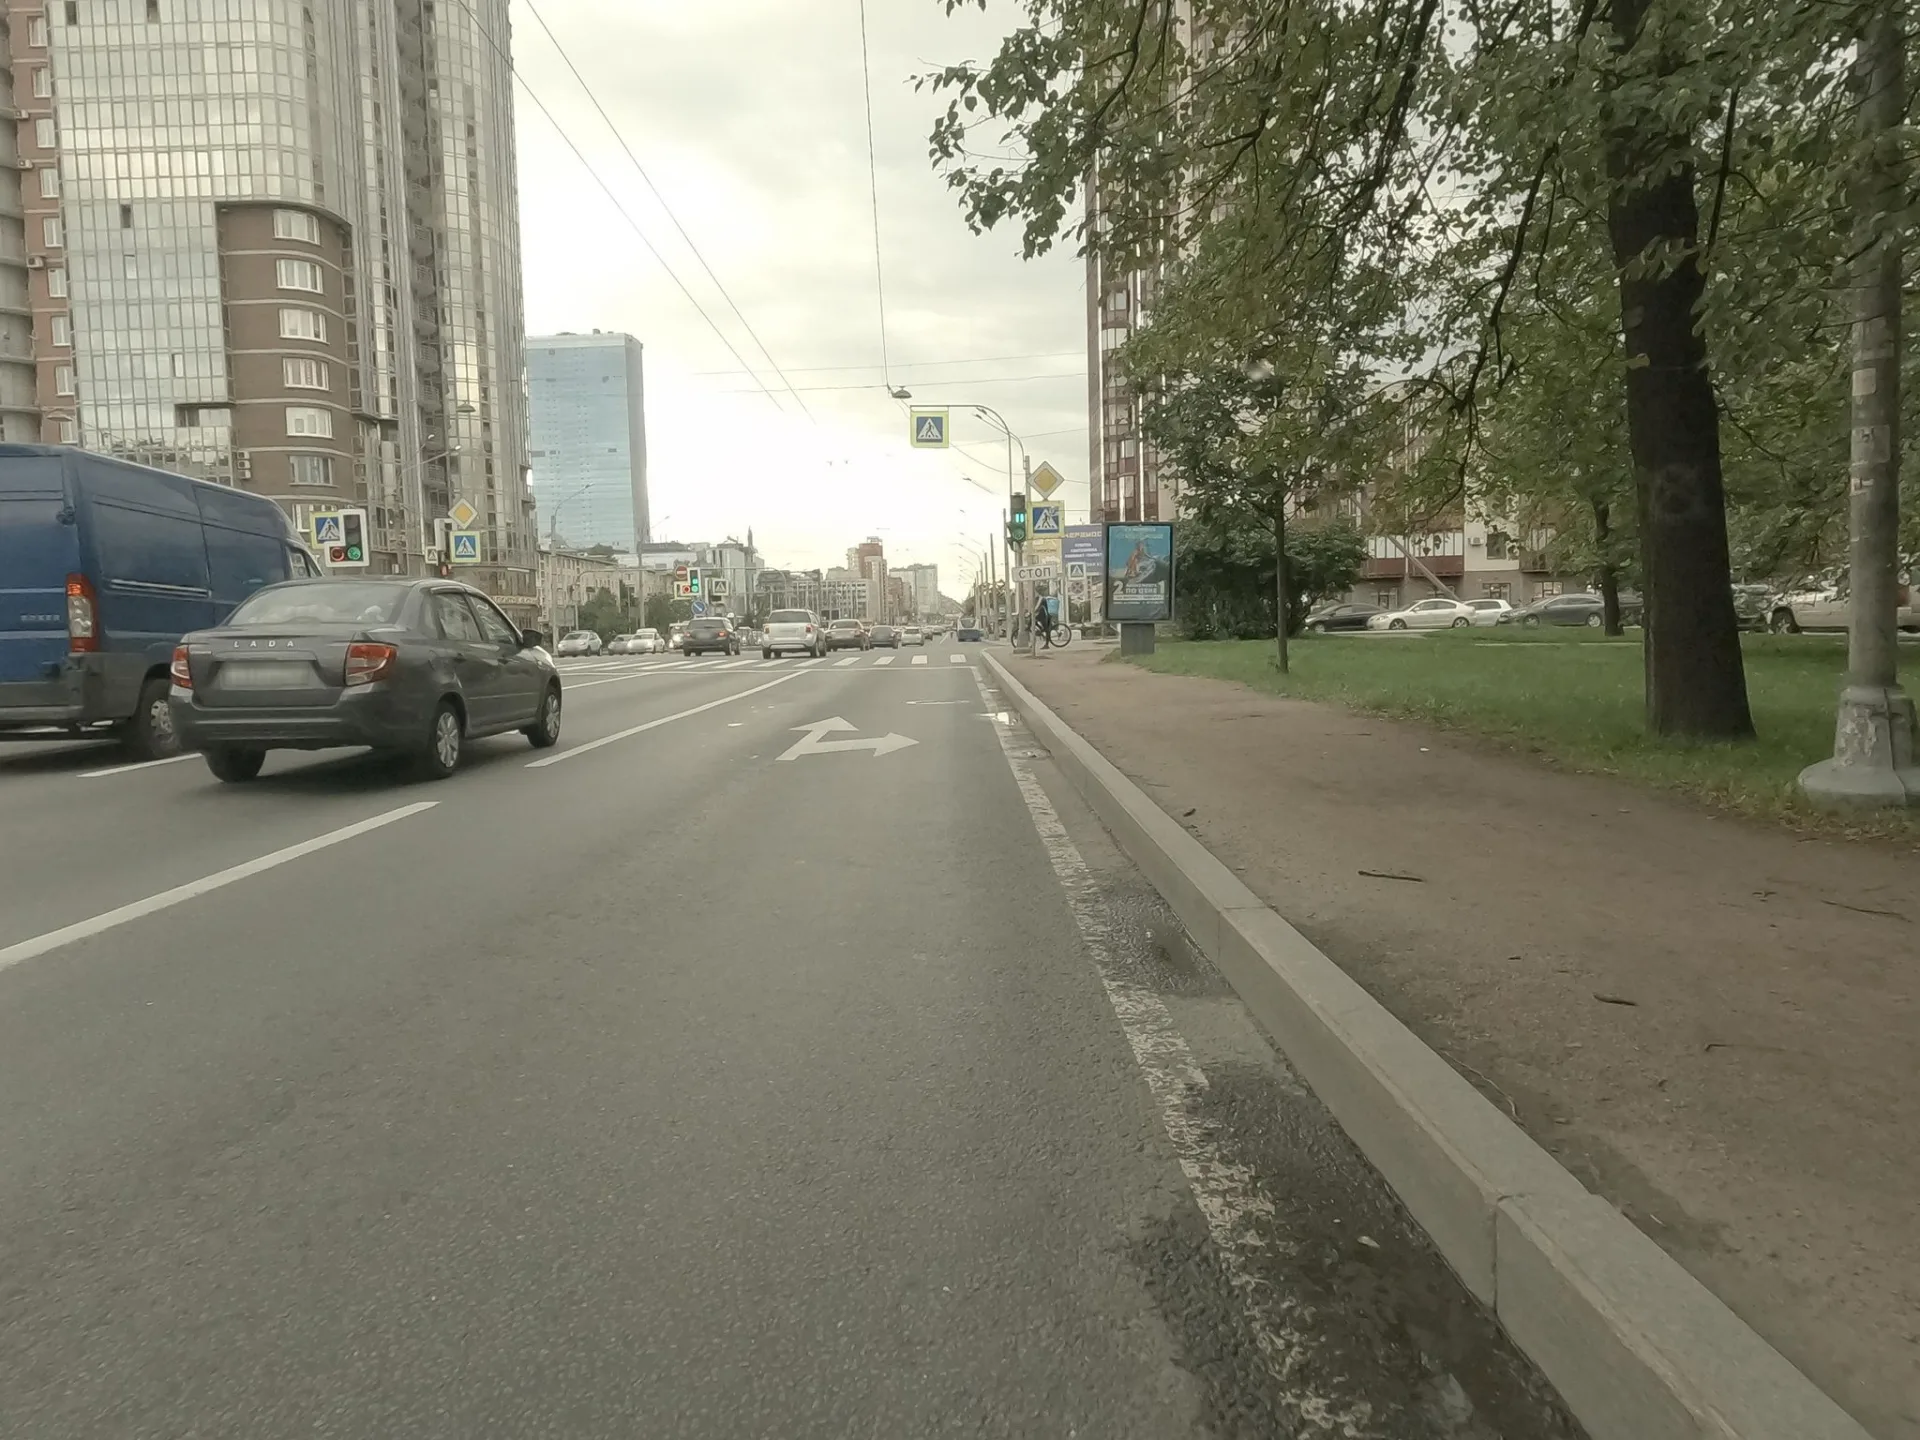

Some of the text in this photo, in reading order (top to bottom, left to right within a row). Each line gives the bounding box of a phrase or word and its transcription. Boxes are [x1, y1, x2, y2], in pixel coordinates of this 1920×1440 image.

[1019, 567, 1051, 579] СТОП
[1113, 580, 1124, 594] 2
[234, 639, 296, 648] LADA
